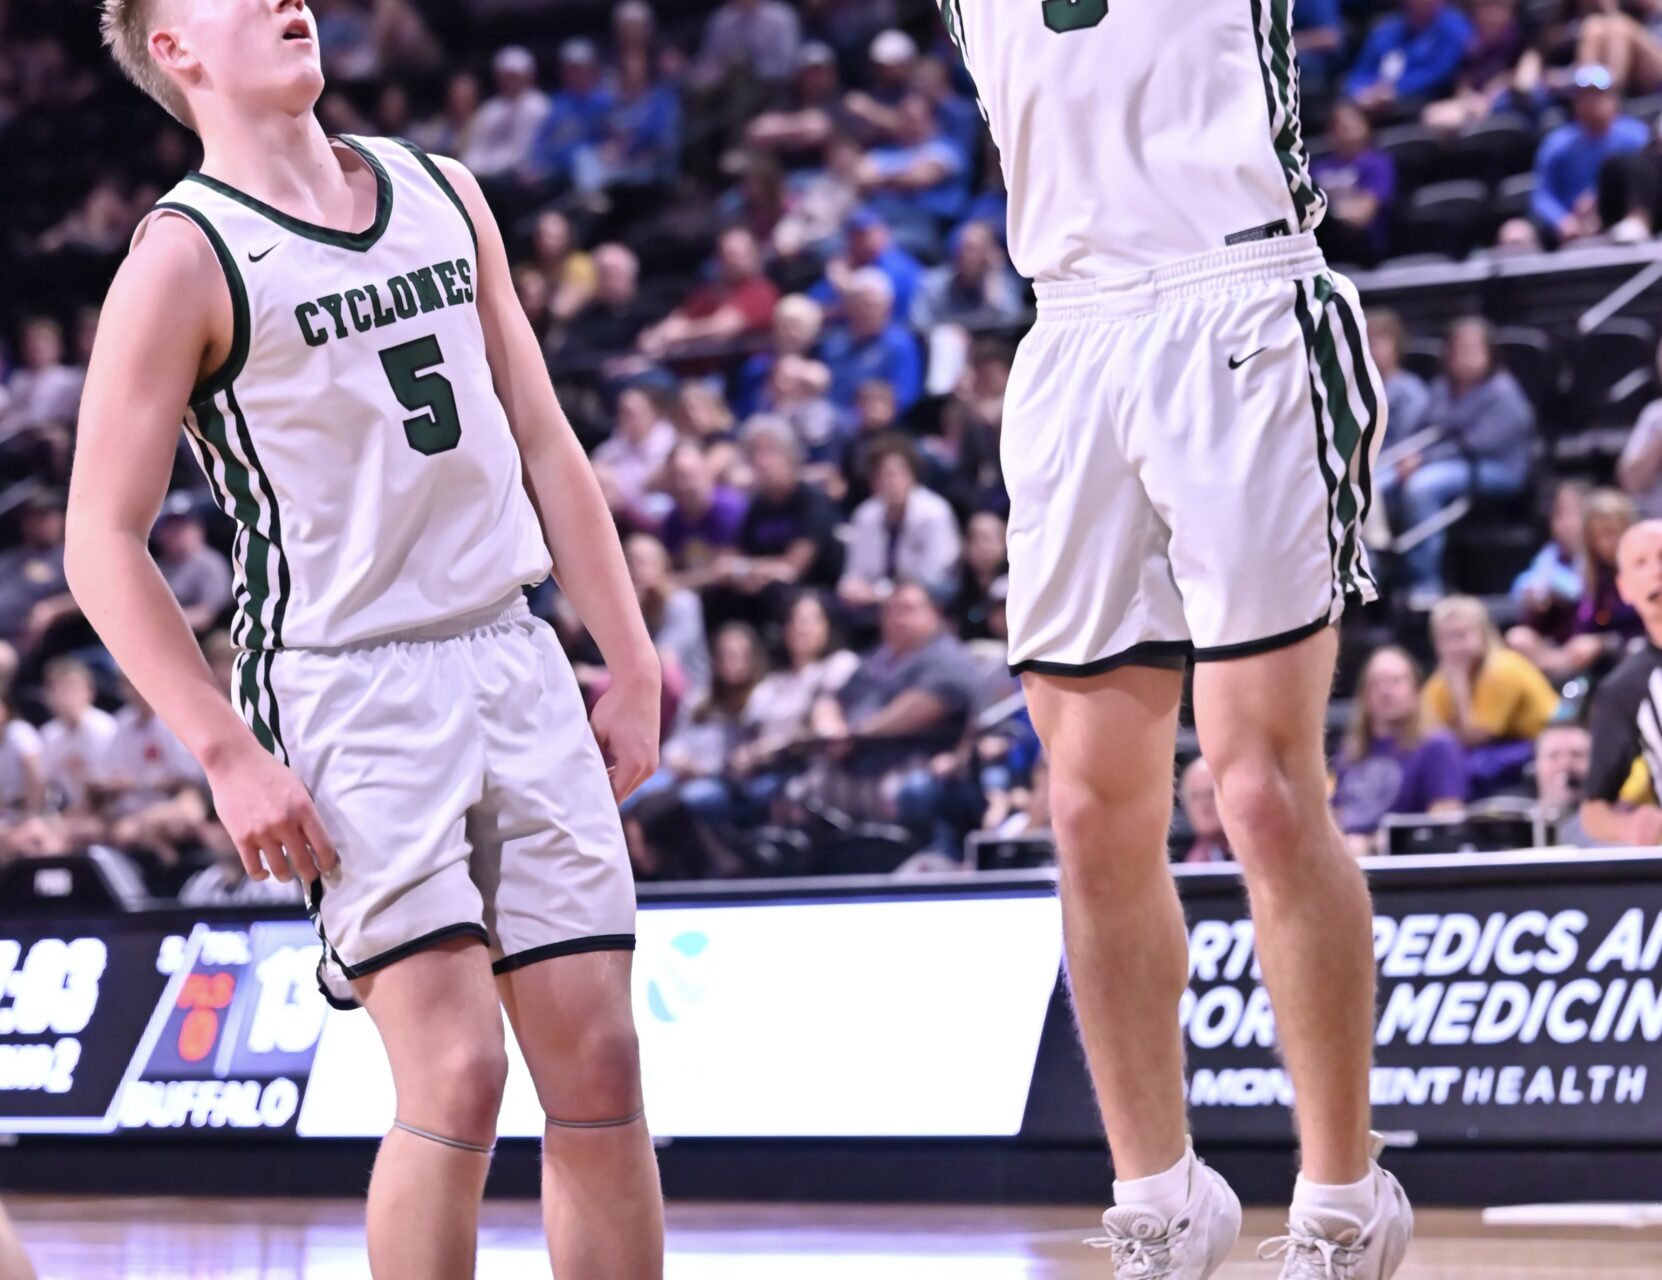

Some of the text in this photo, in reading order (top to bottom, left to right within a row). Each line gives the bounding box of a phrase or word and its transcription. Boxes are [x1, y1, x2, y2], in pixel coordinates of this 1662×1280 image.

[294, 258, 474, 347] CYCLONES
[378, 333, 462, 456] 5
[117, 1076, 299, 1128] BUFFALO
[1190, 1065, 1648, 1106] MONENT HEALTH
